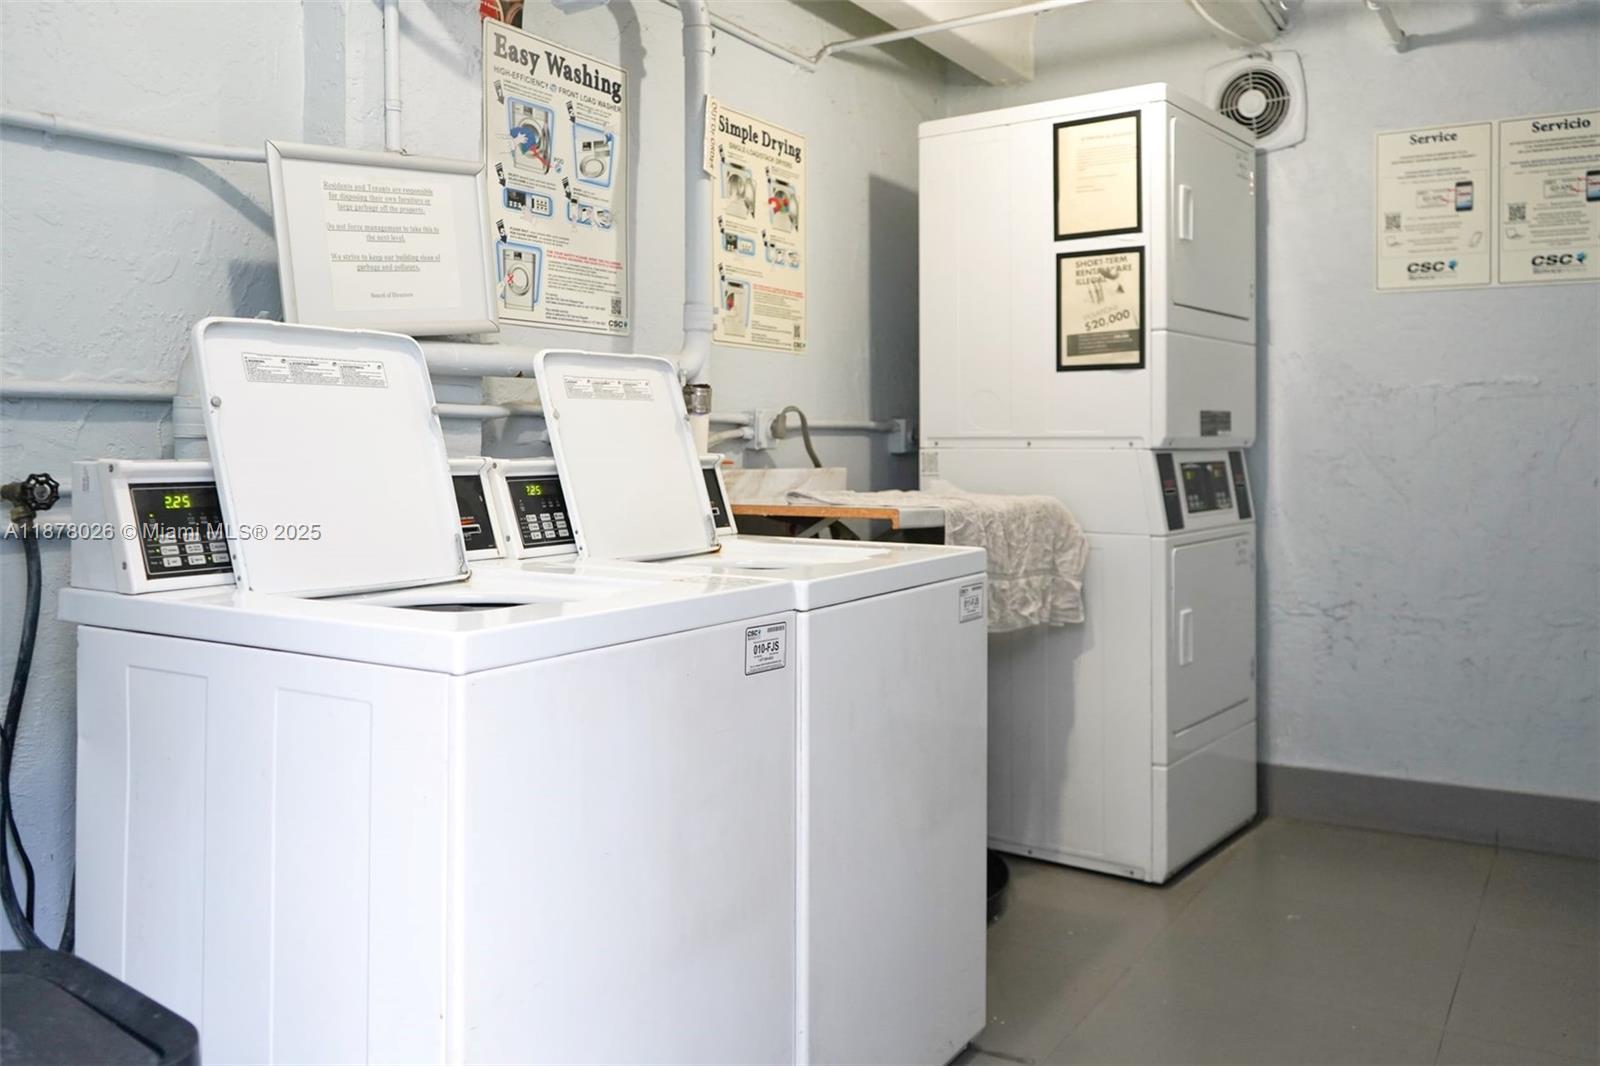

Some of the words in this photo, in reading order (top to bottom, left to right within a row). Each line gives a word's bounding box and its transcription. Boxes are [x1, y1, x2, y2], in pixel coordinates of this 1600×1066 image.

[494, 32, 540, 76] Easy
[544, 51, 622, 104] Washing
[1532, 117, 1591, 133] Servicio
[719, 114, 758, 144] Simple
[761, 130, 801, 163] Drying
[1410, 131, 1457, 145] Service
[1531, 253, 1573, 266] CSC
[1408, 261, 1445, 273] CSC
[608, 320, 623, 328] CSC
[1085, 309, 1130, 331] $20,000
[164, 495, 191, 509] 2.25
[753, 641, 779, 655] 010-FJS
